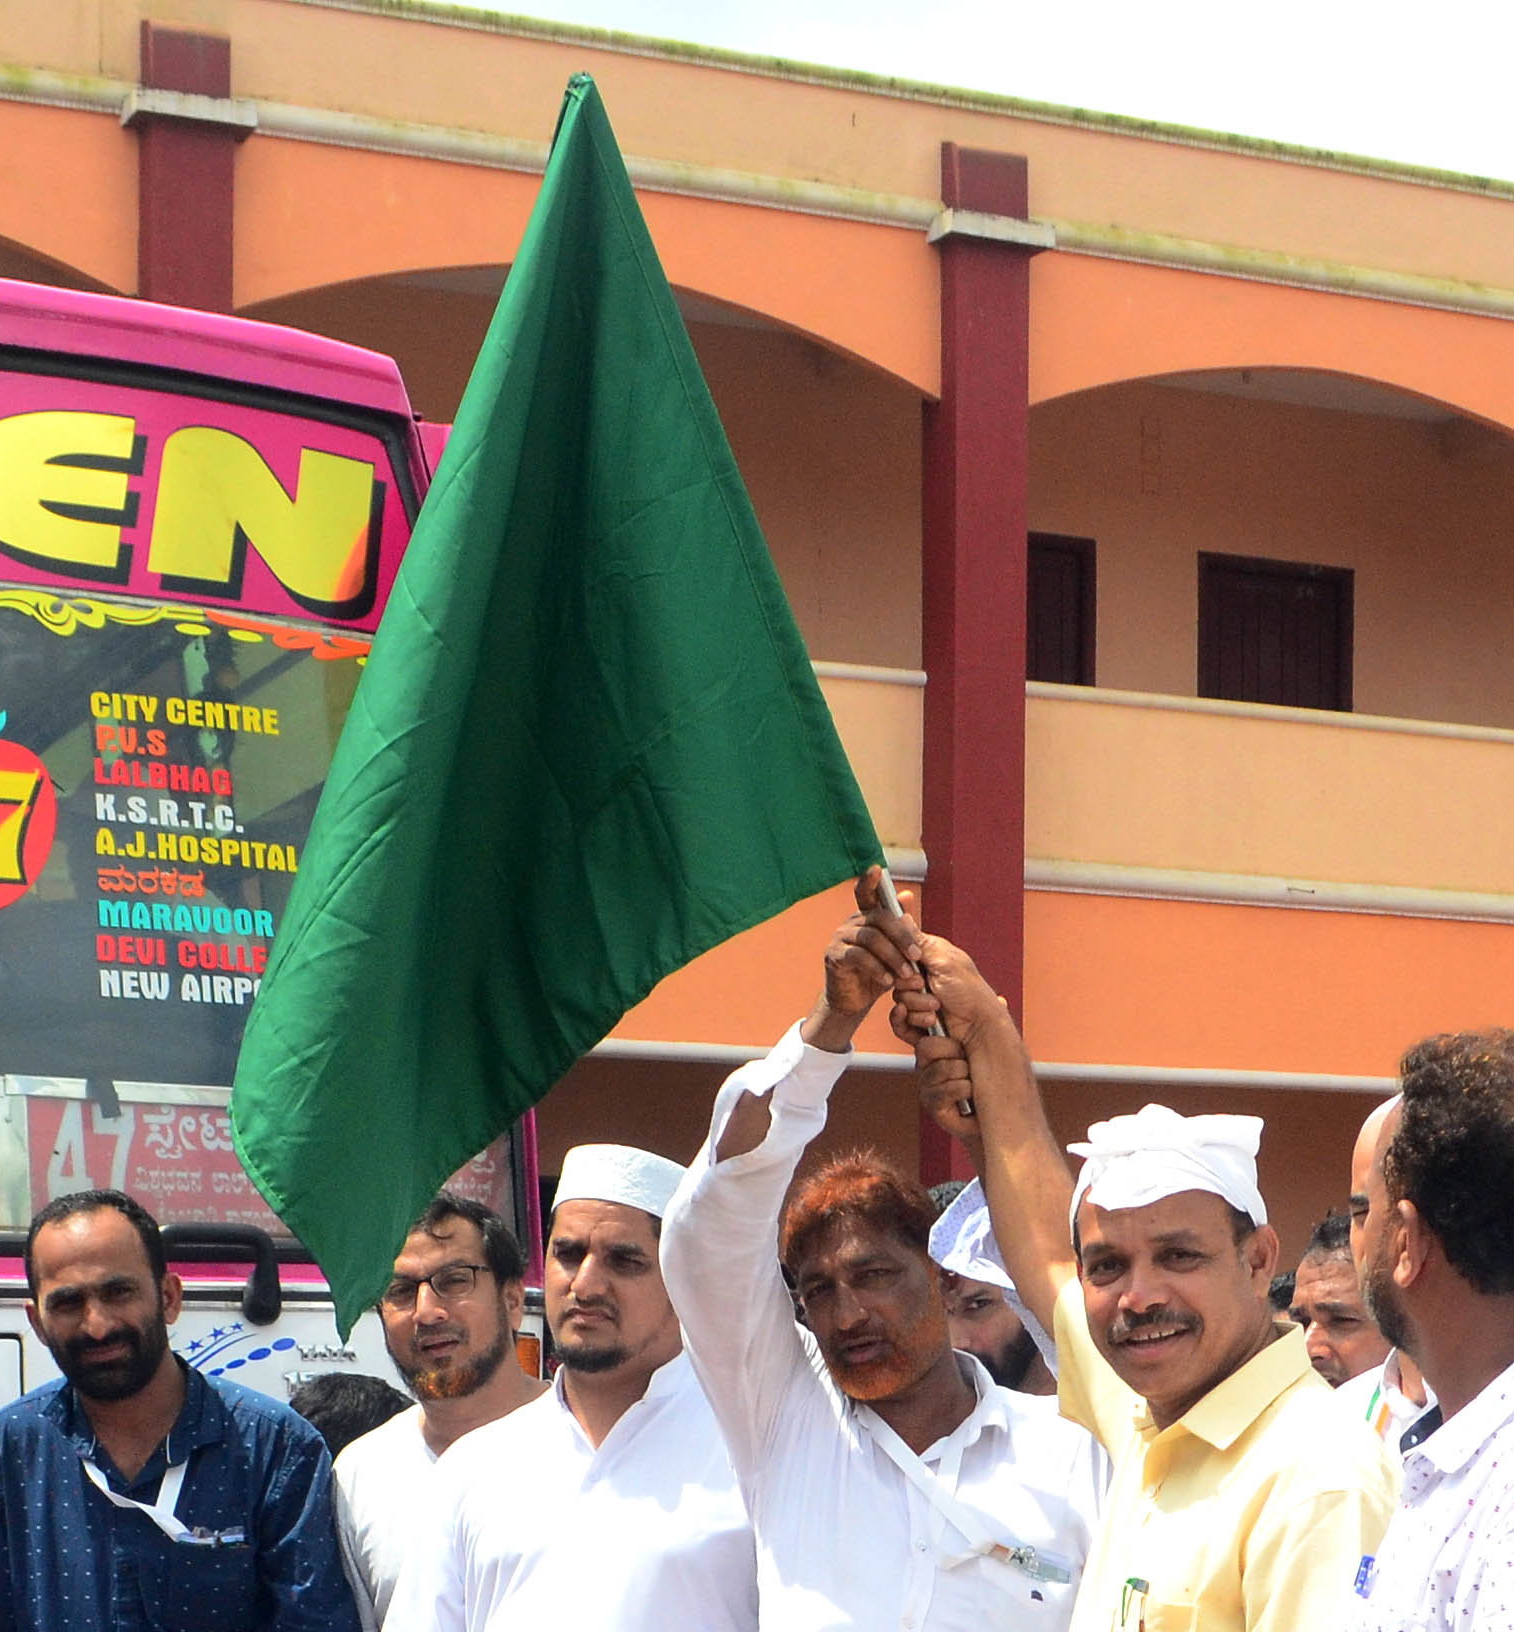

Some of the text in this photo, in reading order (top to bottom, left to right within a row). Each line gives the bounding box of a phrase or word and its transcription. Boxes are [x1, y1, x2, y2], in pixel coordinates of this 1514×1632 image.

[90, 691, 280, 736] CITY CENTRE
[93, 757, 233, 796] LALBHAG
[95, 793, 245, 834] K.S.R.T.C.
[97, 899, 275, 937] MARAVOOR
[96, 934, 269, 975] DEVI COLLE
[99, 969, 262, 1006] NEW AIRP
